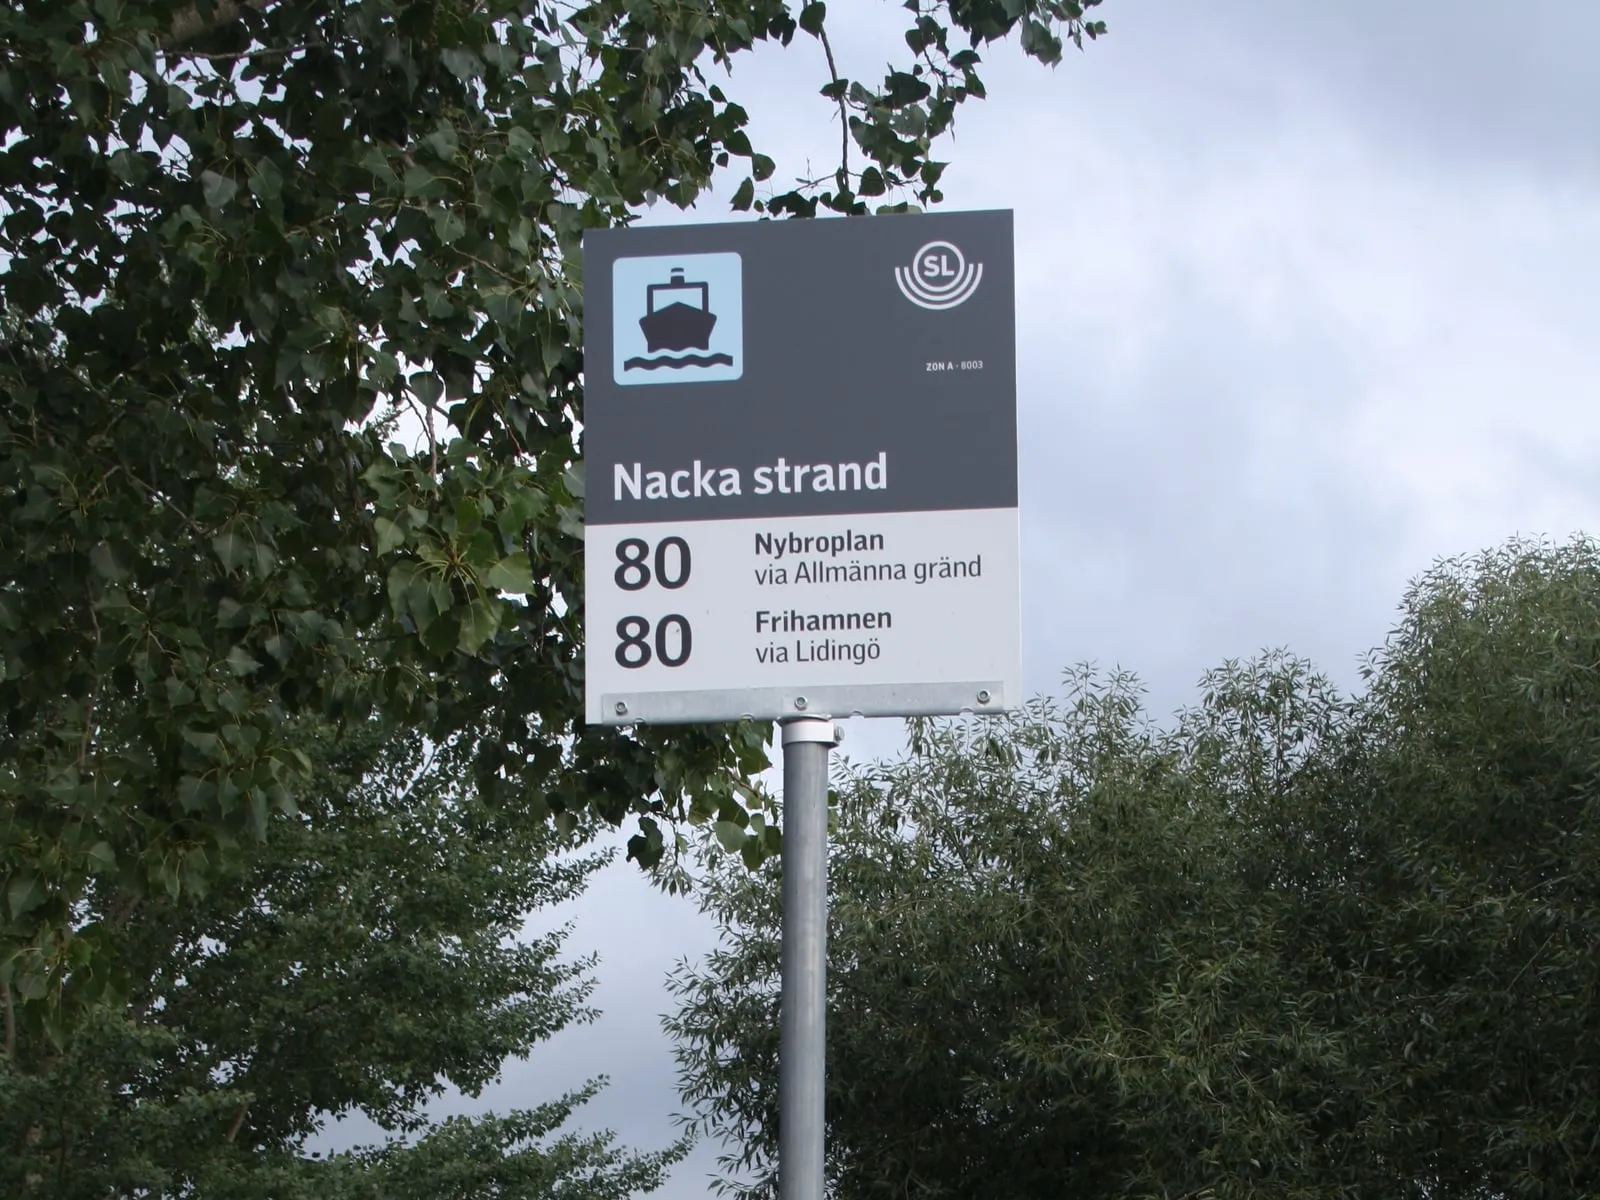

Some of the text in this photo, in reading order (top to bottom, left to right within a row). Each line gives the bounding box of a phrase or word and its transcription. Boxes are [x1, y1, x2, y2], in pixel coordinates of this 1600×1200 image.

[923, 254, 955, 278] SL
[926, 362, 945, 372] ZON
[946, 361, 954, 371] A
[960, 360, 984, 370] 8003
[614, 451, 888, 501] Nacka strand
[755, 529, 885, 560] Nybroplan
[613, 535, 693, 592] 80
[754, 554, 983, 586] via Allmänna gränd
[755, 609, 893, 634] Frihamnen
[614, 613, 693, 670] 80
[755, 637, 882, 666] via Lidingö
